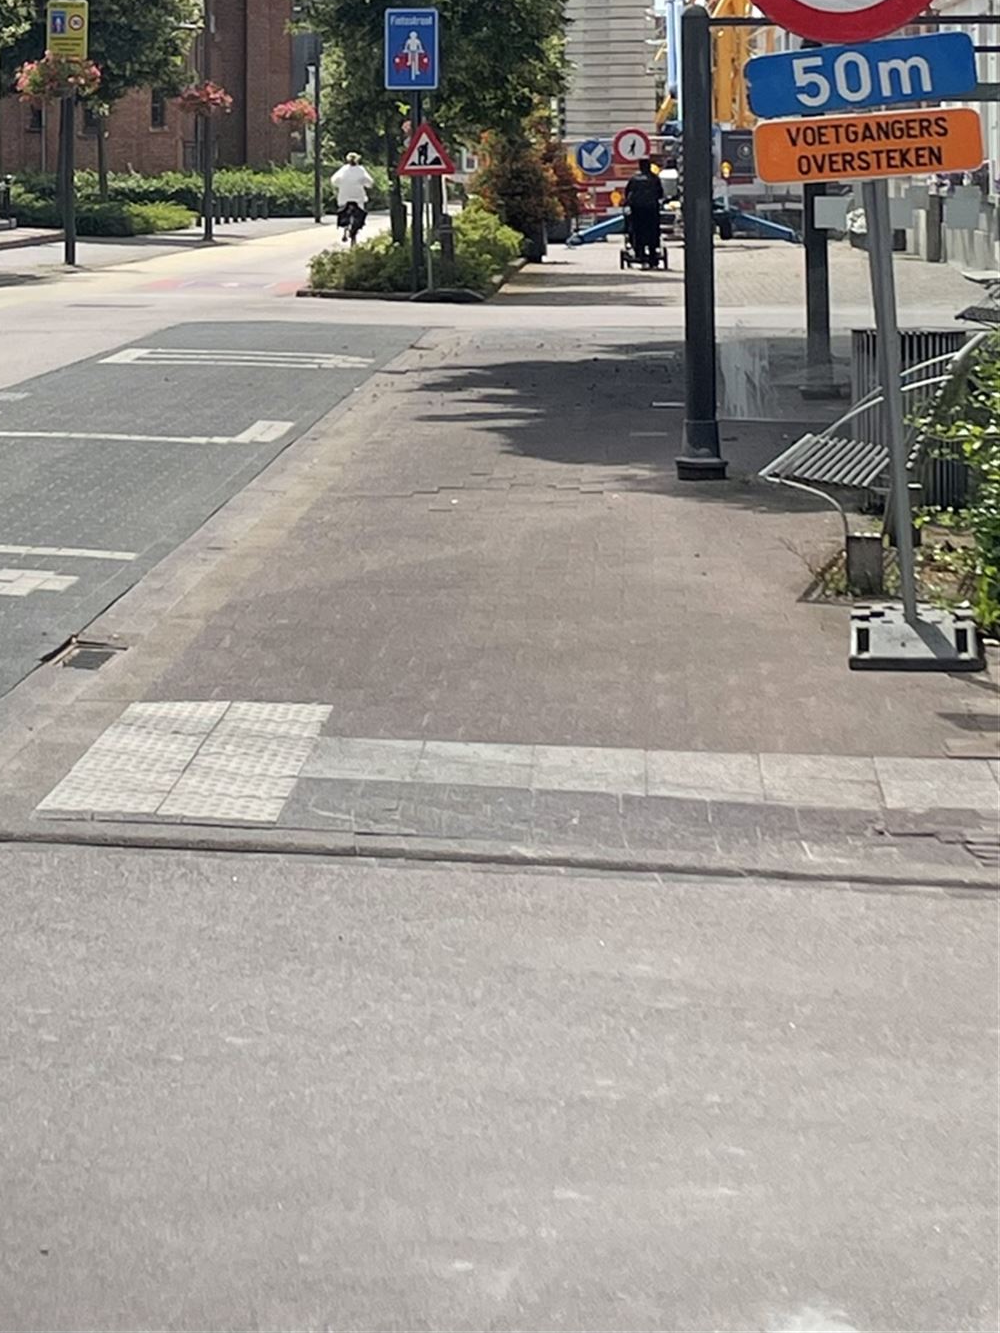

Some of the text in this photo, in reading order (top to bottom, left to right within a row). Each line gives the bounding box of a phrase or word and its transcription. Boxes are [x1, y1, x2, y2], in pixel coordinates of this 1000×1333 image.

[793, 51, 932, 107] 50m
[786, 117, 948, 147] VOETGANGERS
[797, 147, 943, 175] OVERSTEKEN
